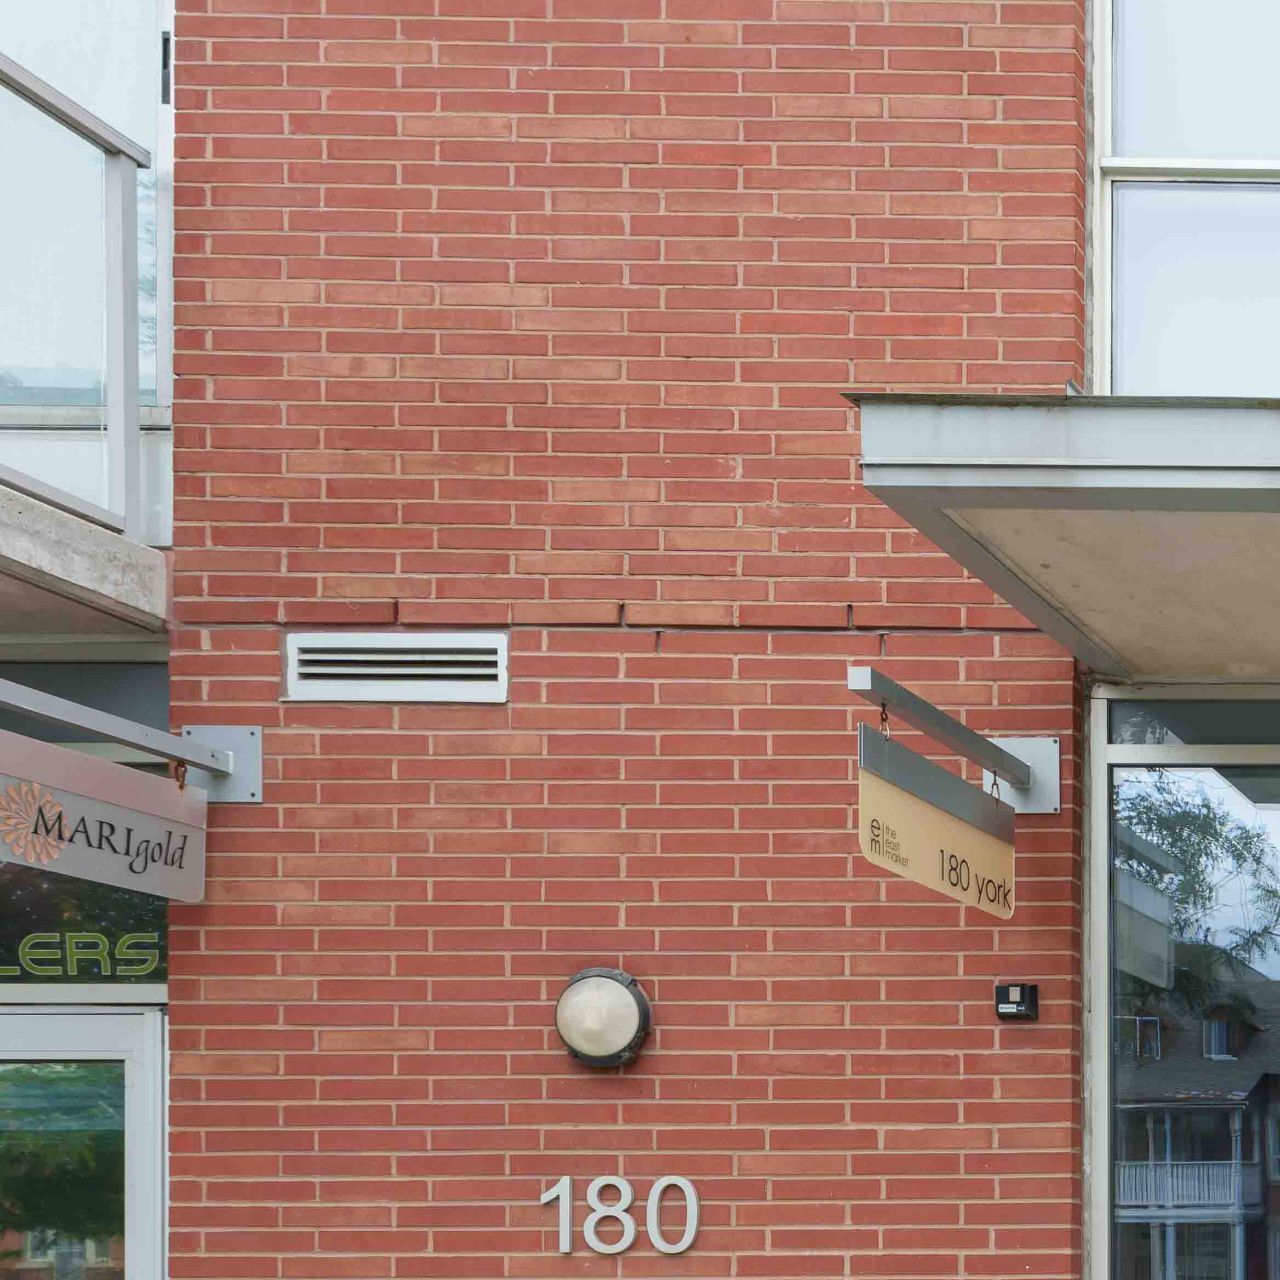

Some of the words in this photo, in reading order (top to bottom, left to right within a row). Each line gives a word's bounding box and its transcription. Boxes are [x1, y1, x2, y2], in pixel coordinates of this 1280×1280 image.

[32, 805, 188, 874] MARIgold
[938, 849, 970, 892] 180
[975, 873, 1012, 911] york
[540, 1175, 699, 1255] 180
